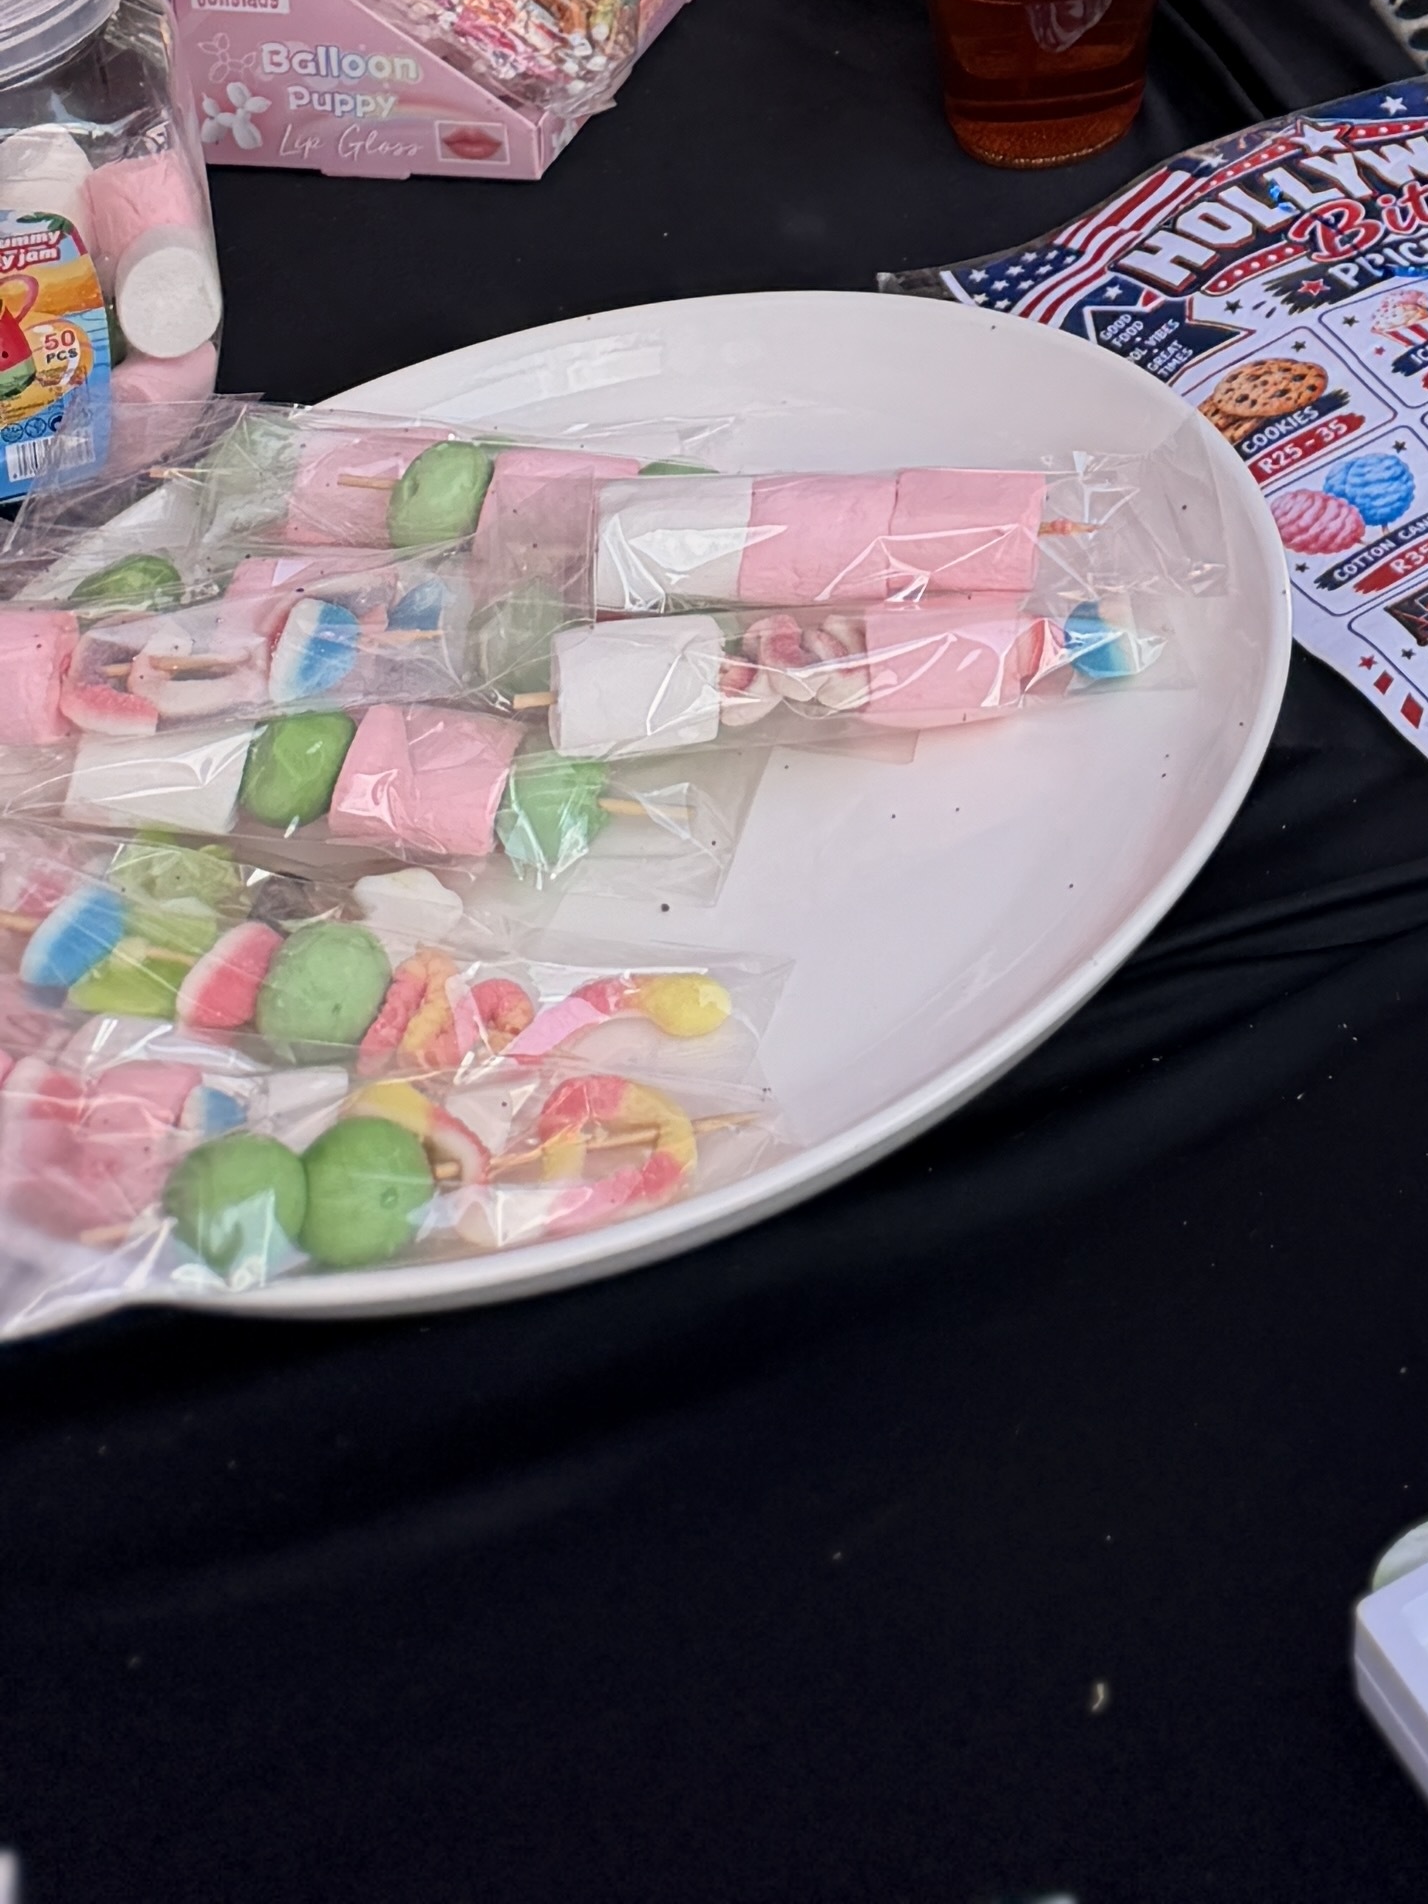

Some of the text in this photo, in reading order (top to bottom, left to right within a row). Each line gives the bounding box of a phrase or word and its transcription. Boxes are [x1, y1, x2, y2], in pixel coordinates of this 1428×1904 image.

[260, 41, 420, 81] Balloon
[286, 85, 397, 119] Puppy
[280, 123, 424, 162] Lip Gloss
[0, 230, 61, 249] ummy
[44, 328, 76, 351] 50
[1100, 314, 1132, 341] GOOD
[1111, 320, 1144, 348] FOOD
[1144, 318, 1180, 346] VIBES
[46, 346, 79, 364] PCS
[1147, 339, 1183, 372] GREAT
[1157, 347, 1194, 378] TIMES
[1240, 405, 1319, 455] COOKIES
[1257, 441, 1303, 475] R25
[1315, 419, 1348, 441] 35
[1332, 538, 1396, 583] COTTON
